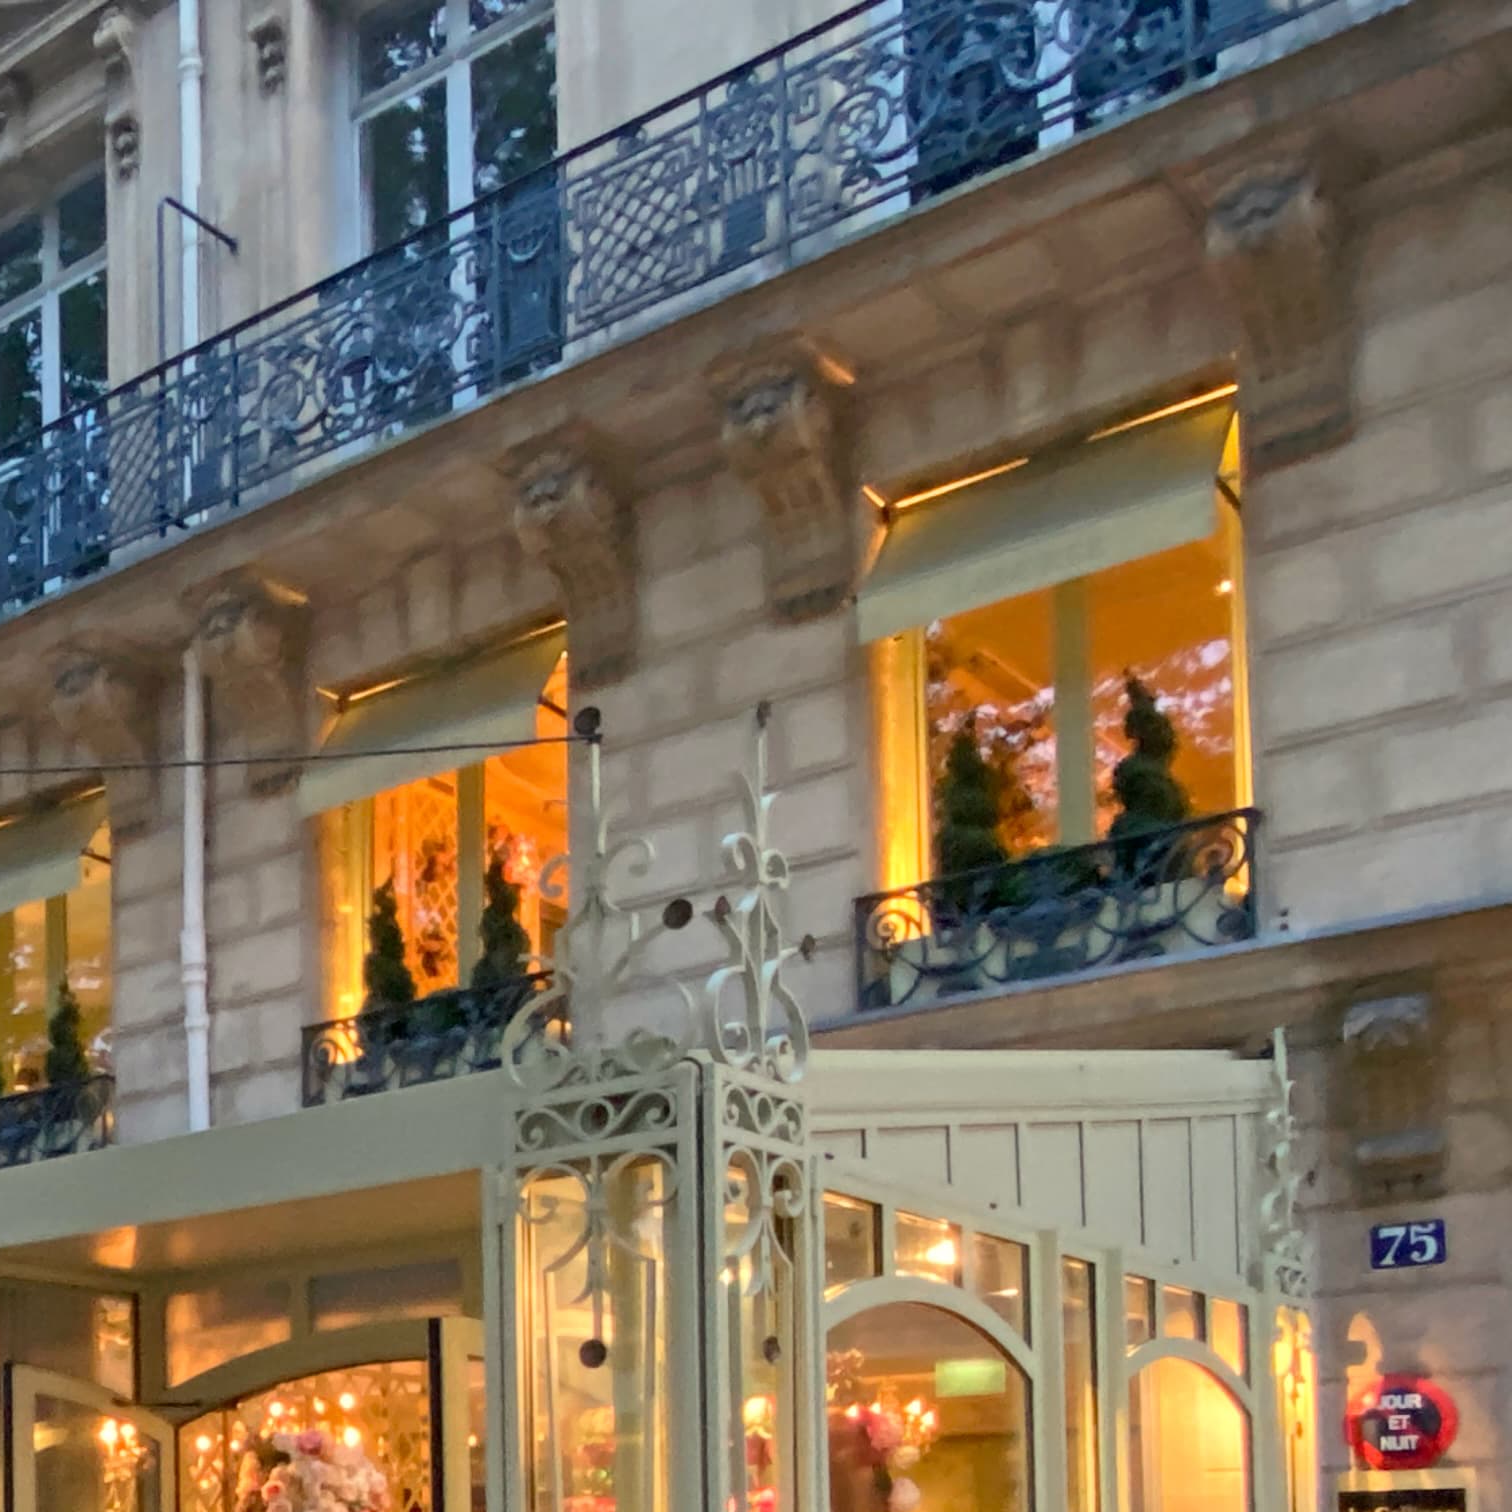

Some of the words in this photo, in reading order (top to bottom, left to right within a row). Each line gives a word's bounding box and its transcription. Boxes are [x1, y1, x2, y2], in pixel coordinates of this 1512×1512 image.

[1378, 1222, 1436, 1266] 75
[1379, 1393, 1423, 1410] JOUR
[1388, 1414, 1411, 1431] ET
[1379, 1434, 1420, 1452] NUIT
